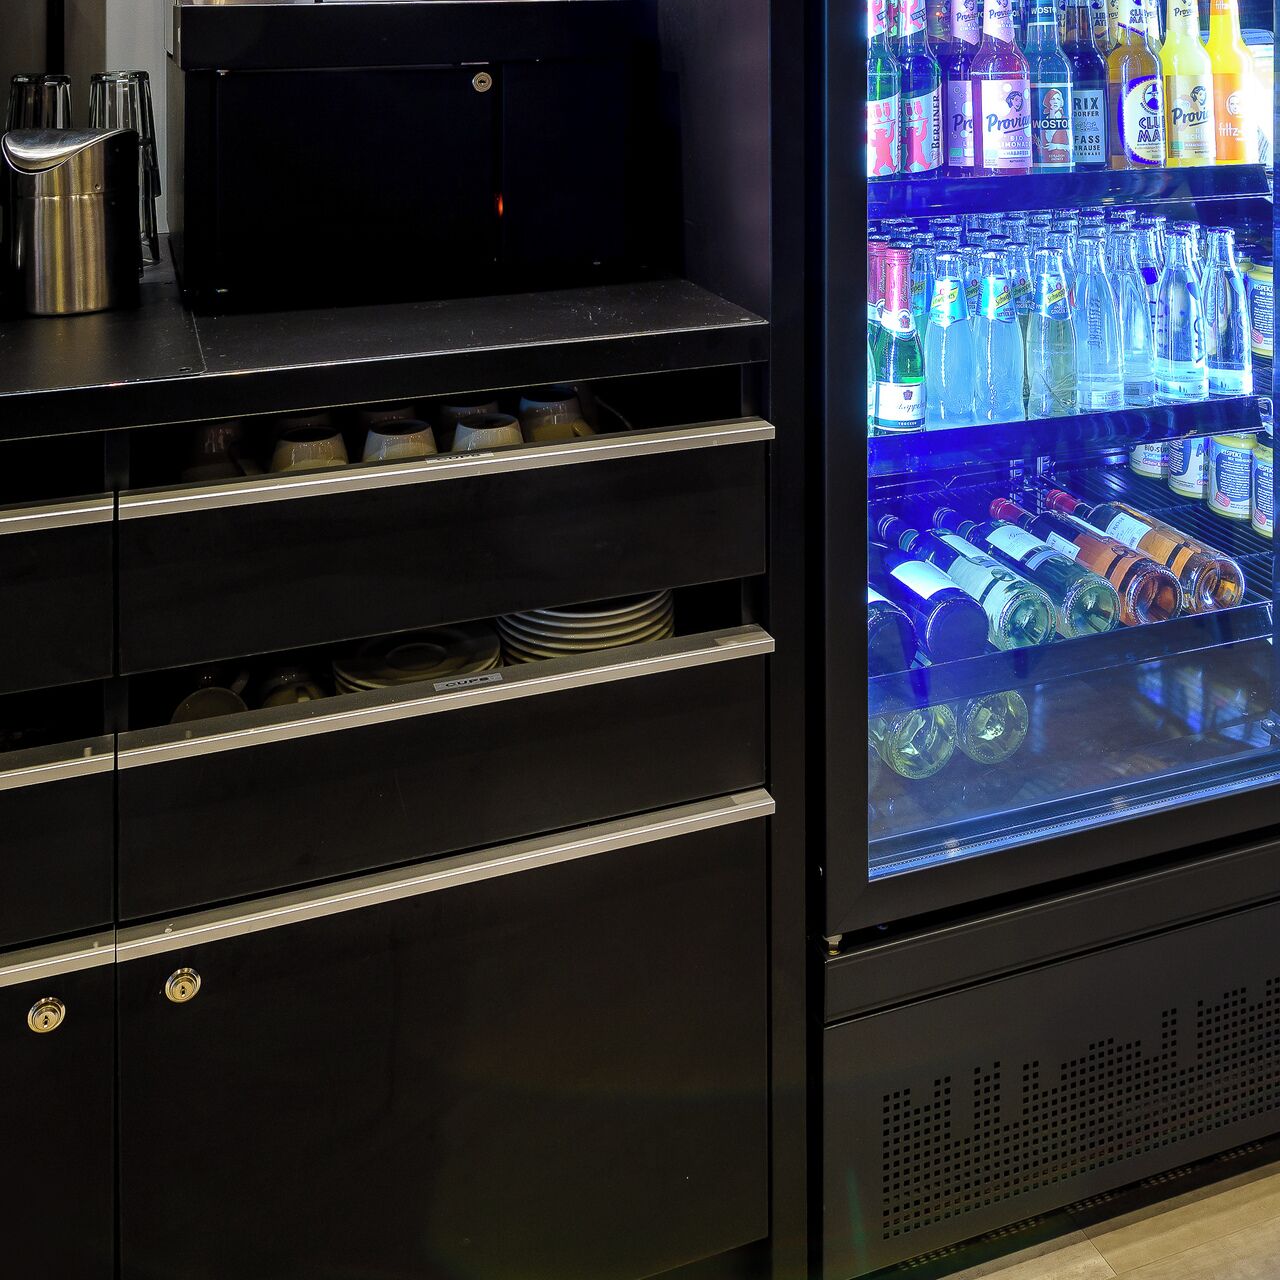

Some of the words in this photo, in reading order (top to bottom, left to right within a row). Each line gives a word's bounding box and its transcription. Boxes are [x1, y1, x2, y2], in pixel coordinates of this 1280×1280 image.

[1074, 97, 1099, 110] RIX
[932, 94, 941, 150] BERLINER
[1032, 120, 1068, 130] WOSTO
[1074, 135, 1101, 144] FASS
[445, 676, 489, 688] CUPS
